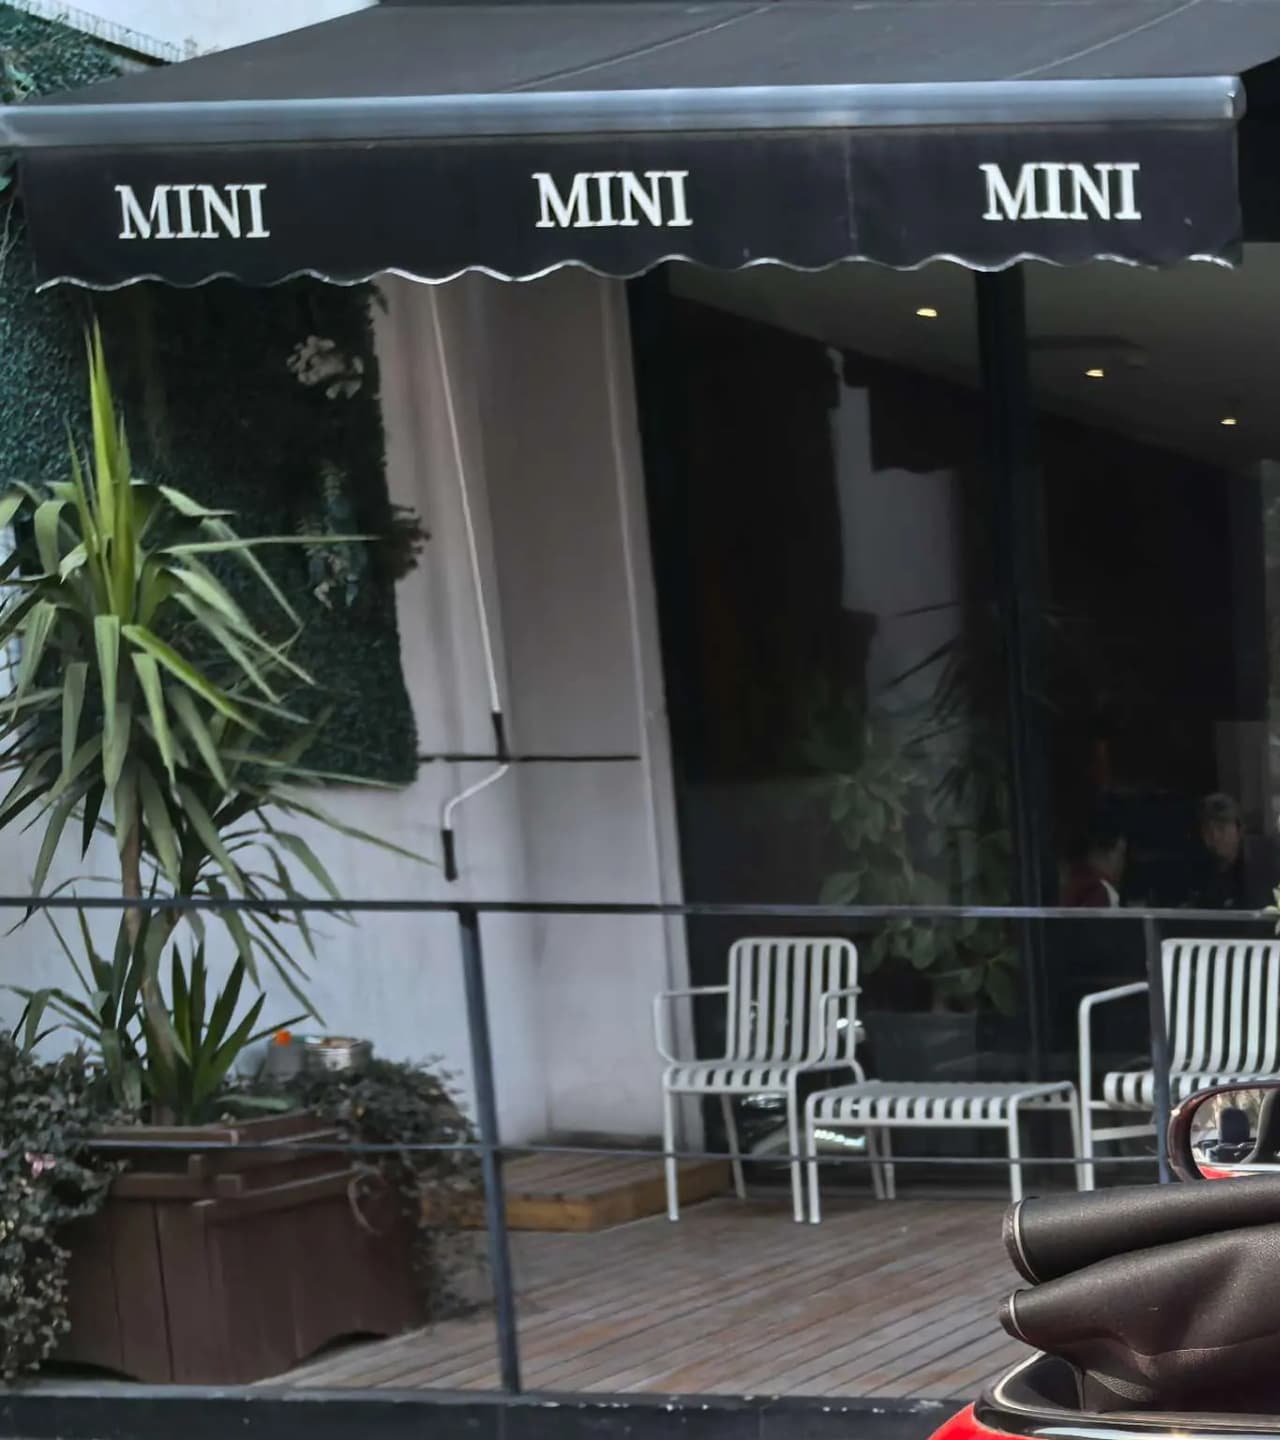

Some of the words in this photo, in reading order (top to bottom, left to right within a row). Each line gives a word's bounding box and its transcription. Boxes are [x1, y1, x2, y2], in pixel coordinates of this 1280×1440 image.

[115, 183, 270, 239] MINI
[532, 170, 693, 228] MINI
[979, 162, 1142, 221] MINI
